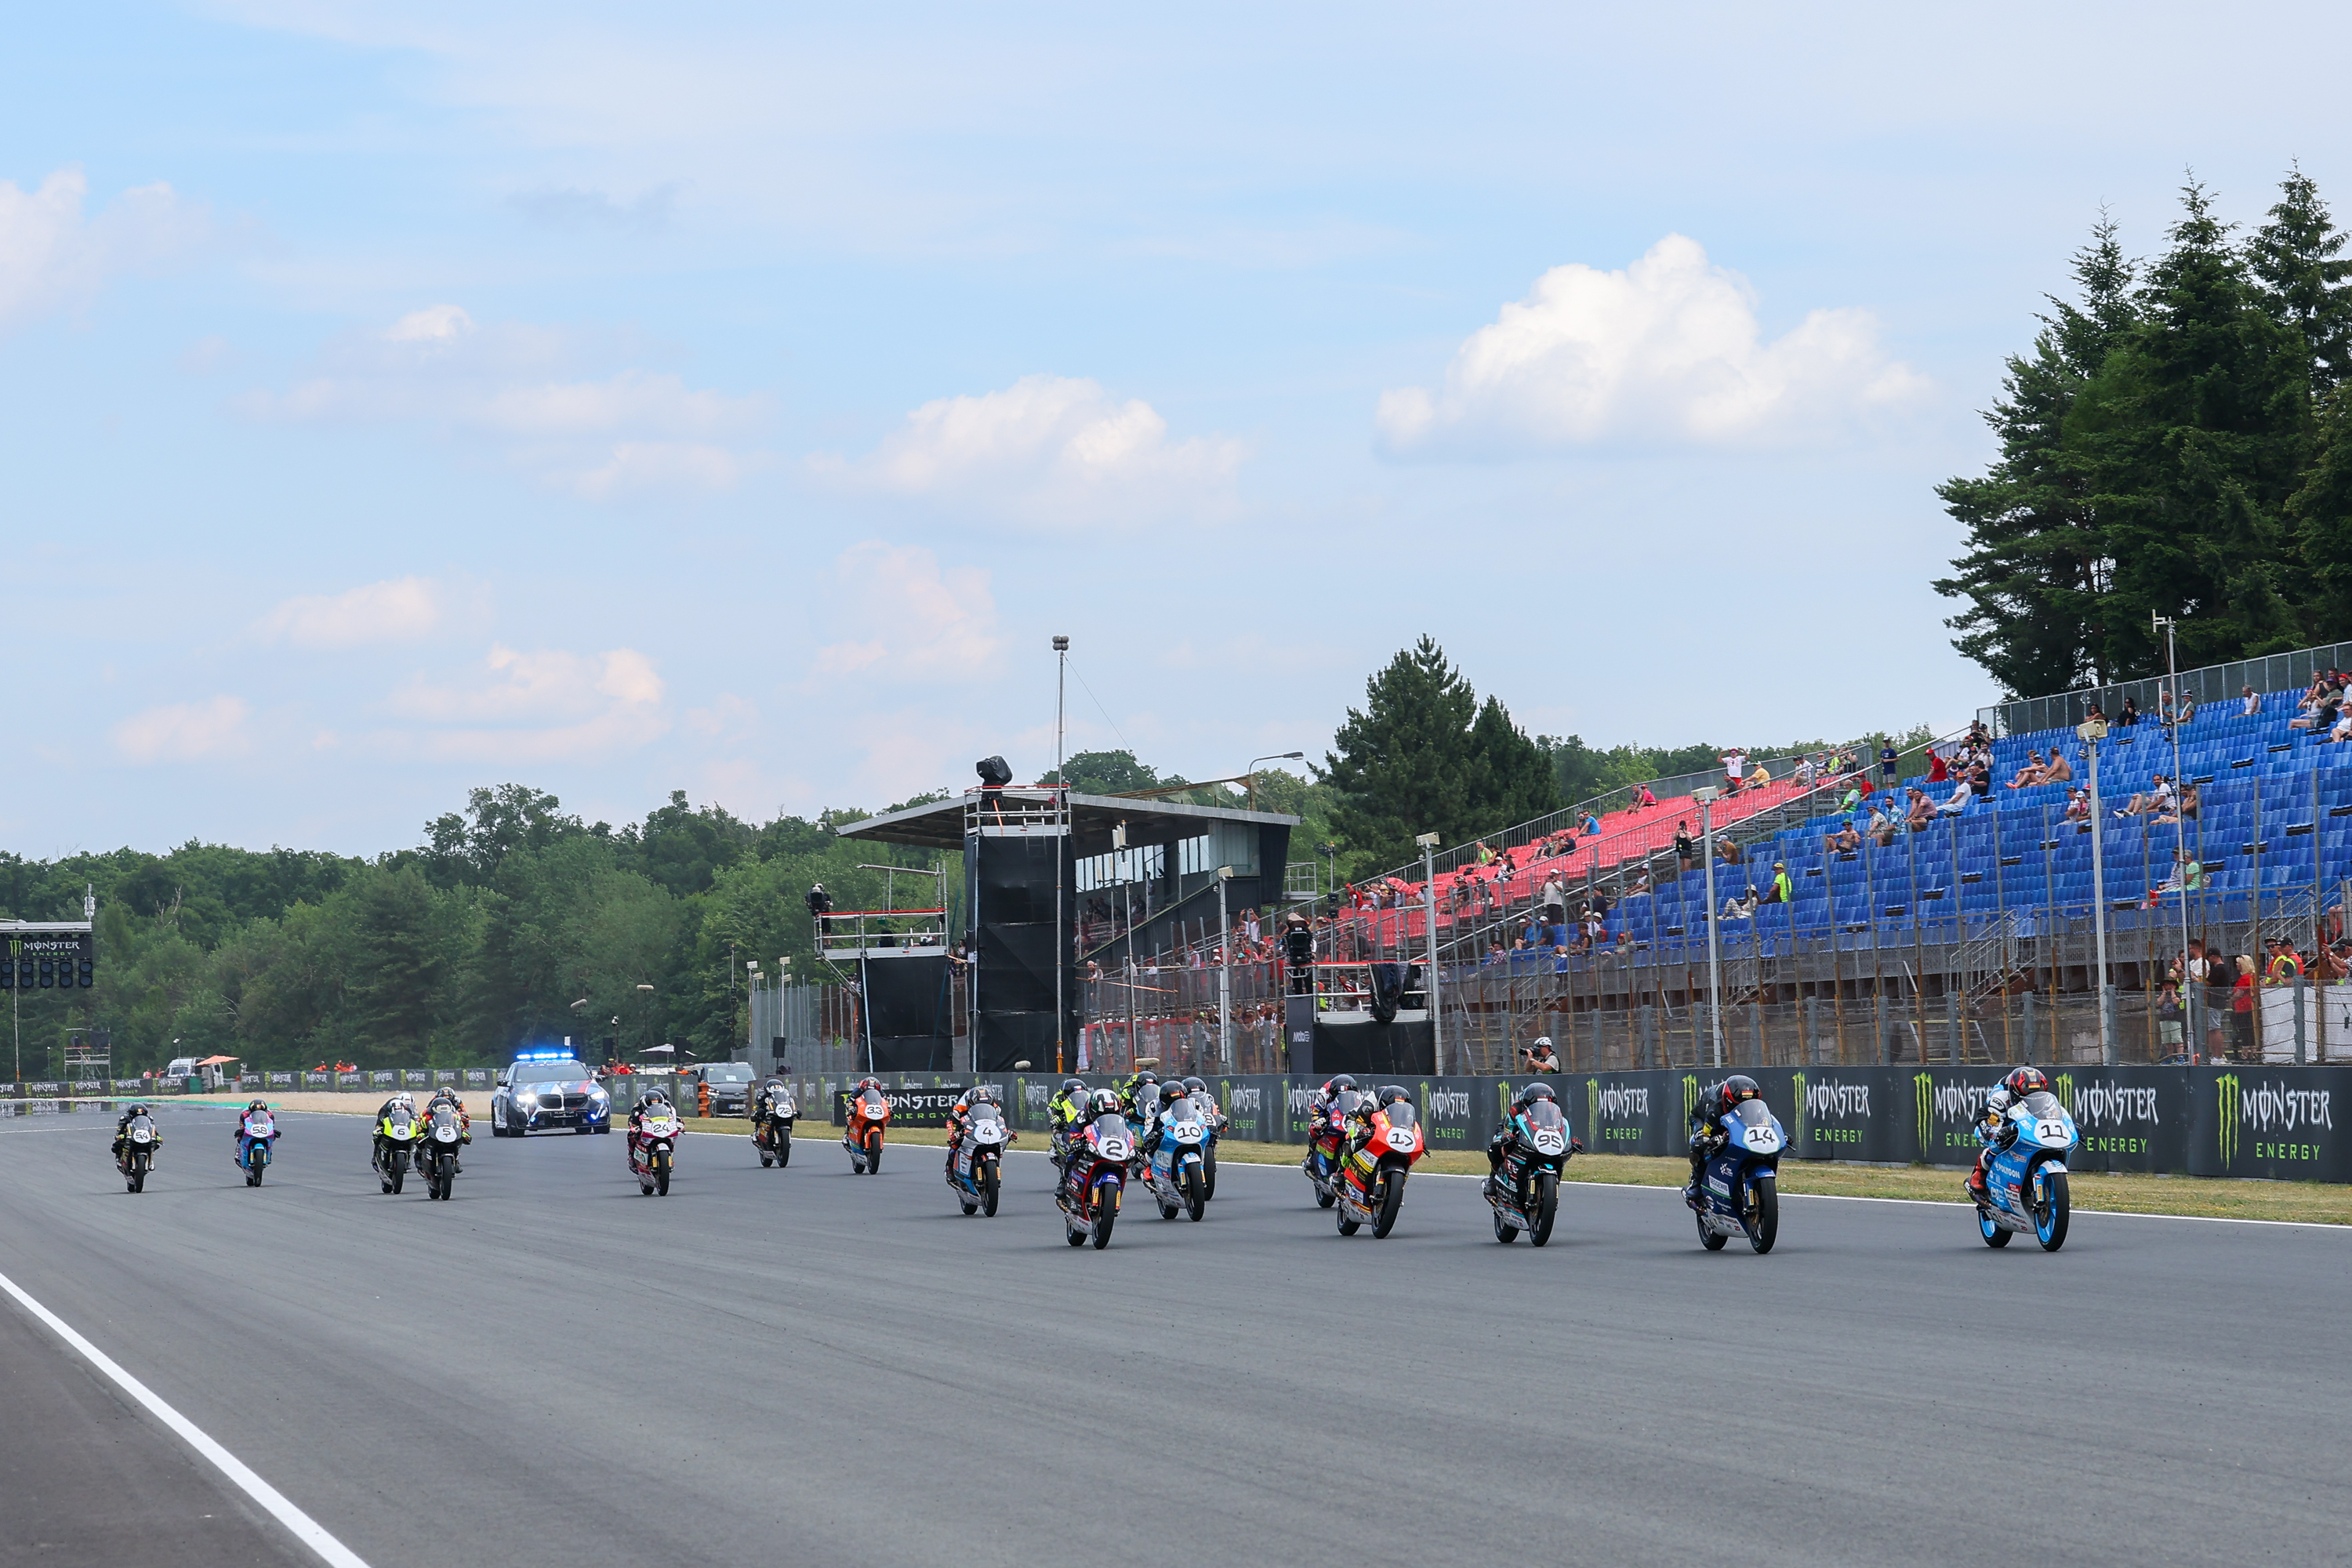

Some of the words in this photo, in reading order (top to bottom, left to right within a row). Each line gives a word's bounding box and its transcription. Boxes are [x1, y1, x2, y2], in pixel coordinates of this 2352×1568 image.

[24, 941, 80, 951] MONSTER
[0, 1084, 15, 1093] STER
[886, 1094, 958, 1109] ONSTER
[1429, 1087, 1470, 1121] MONSTER
[1599, 1082, 1649, 1120] MONSTER
[1806, 1077, 1871, 1120] MONSTER
[1935, 1078, 1992, 1123] MONST
[2074, 1079, 2159, 1127] MONSTER
[867, 1106, 883, 1115] 33
[2242, 1080, 2332, 1132] MONSTER
[252, 1126, 268, 1135] 58
[442, 1127, 452, 1137] 5
[653, 1123, 670, 1133] 24
[982, 1127, 993, 1137] 4
[1178, 1126, 1201, 1139] 10
[1436, 1127, 1465, 1139] ENERGY
[1606, 1127, 1642, 1140] ENERGY
[2041, 1124, 2068, 1140] 11
[136, 1131, 149, 1141] 54
[1390, 1133, 1414, 1147] 17
[1537, 1134, 1562, 1149] 95
[1749, 1129, 1775, 1144] 14
[1815, 1129, 1863, 1142] ENERGY
[1946, 1133, 1984, 1147] ENER
[1106, 1140, 1123, 1158] 2
[2087, 1137, 2147, 1152] ENERGY
[2256, 1142, 2320, 1160] ENERGY
[1998, 1163, 2020, 1179] POLYGON
